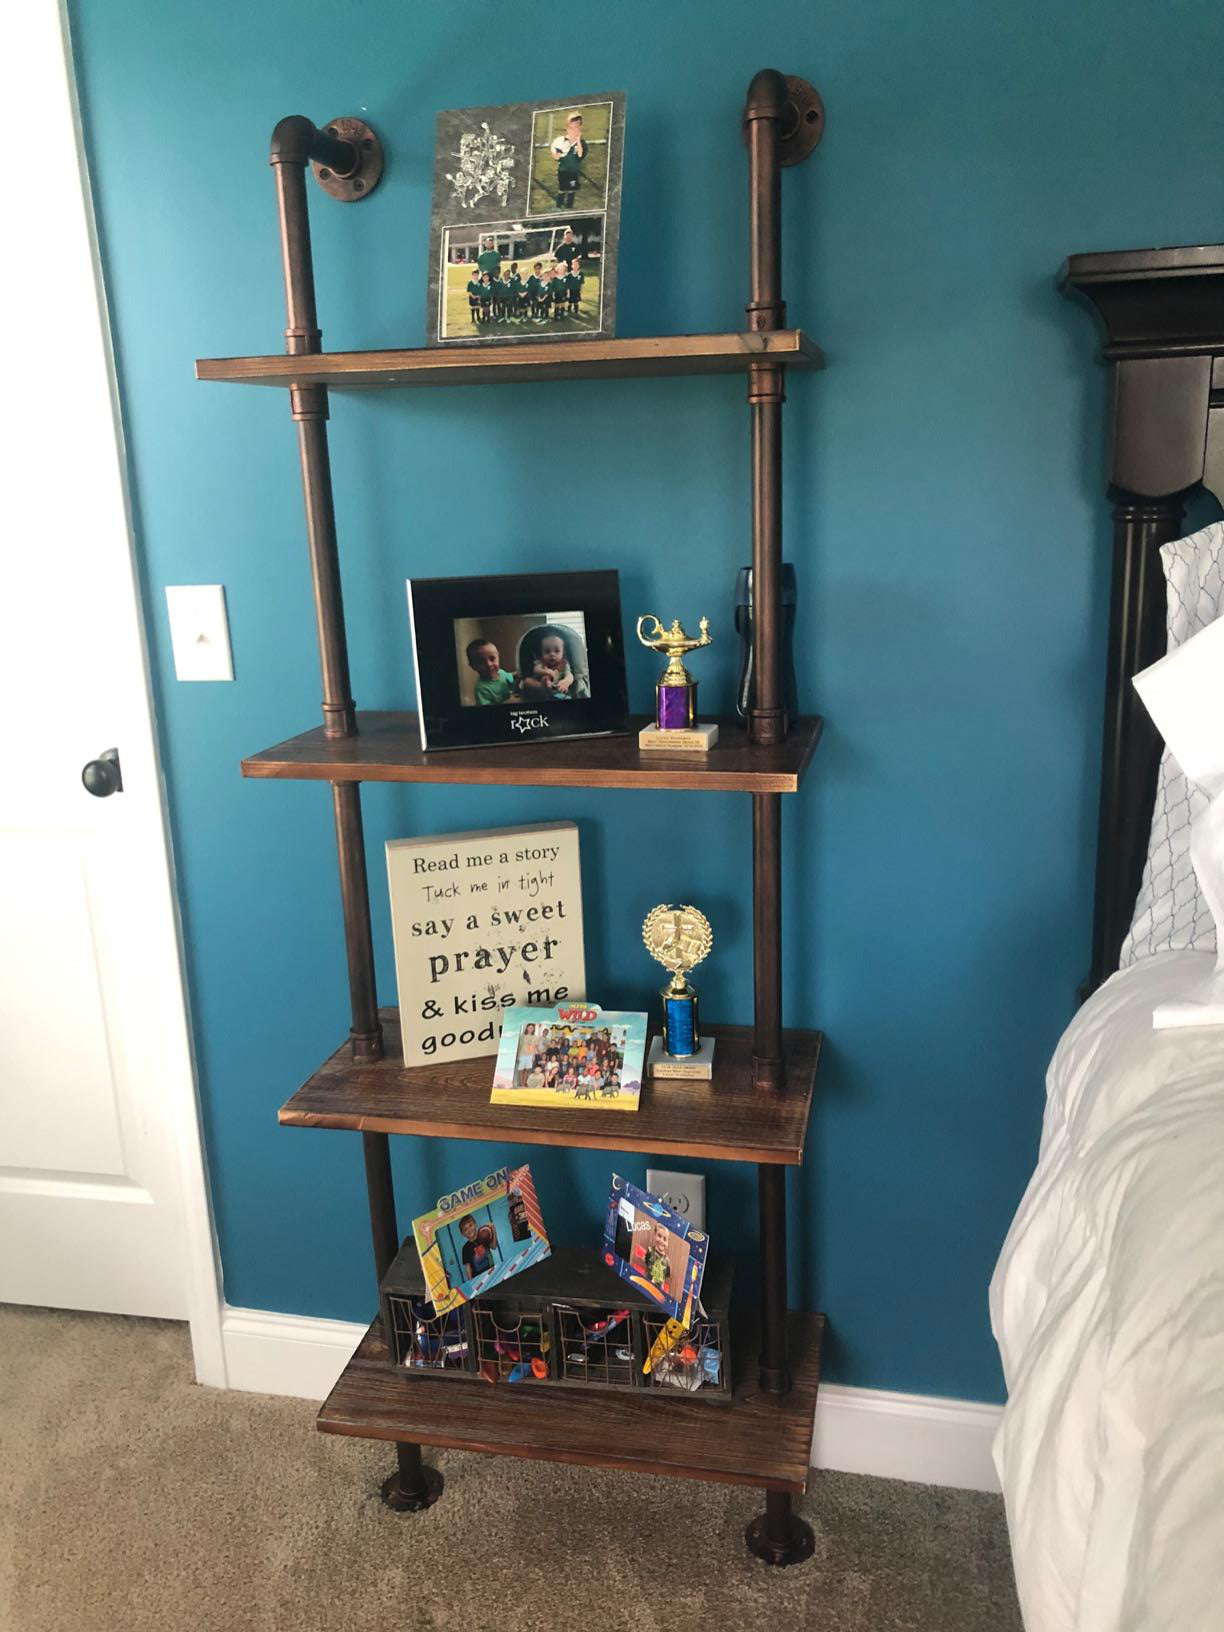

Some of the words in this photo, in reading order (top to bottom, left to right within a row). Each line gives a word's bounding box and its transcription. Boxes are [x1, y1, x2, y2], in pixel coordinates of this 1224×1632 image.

[412, 853, 460, 874] Read
[466, 854, 493, 868] me
[499, 852, 509, 864] a
[515, 846, 560, 862] story
[422, 881, 461, 902] Tuck
[470, 882, 488, 894] me
[498, 875, 510, 893] in
[518, 869, 555, 897] tight
[411, 918, 455, 939] say
[466, 913, 480, 930] a
[490, 900, 567, 927] sweet
[428, 937, 559, 983] prayer
[421, 999, 444, 1020] &
[453, 993, 516, 1015] kiss
[527, 985, 569, 1004] me
[558, 1007, 598, 1021] WILD
[421, 1021, 503, 1055] good
[440, 1181, 482, 1211] GAME
[626, 1220, 651, 1232] Lucas
